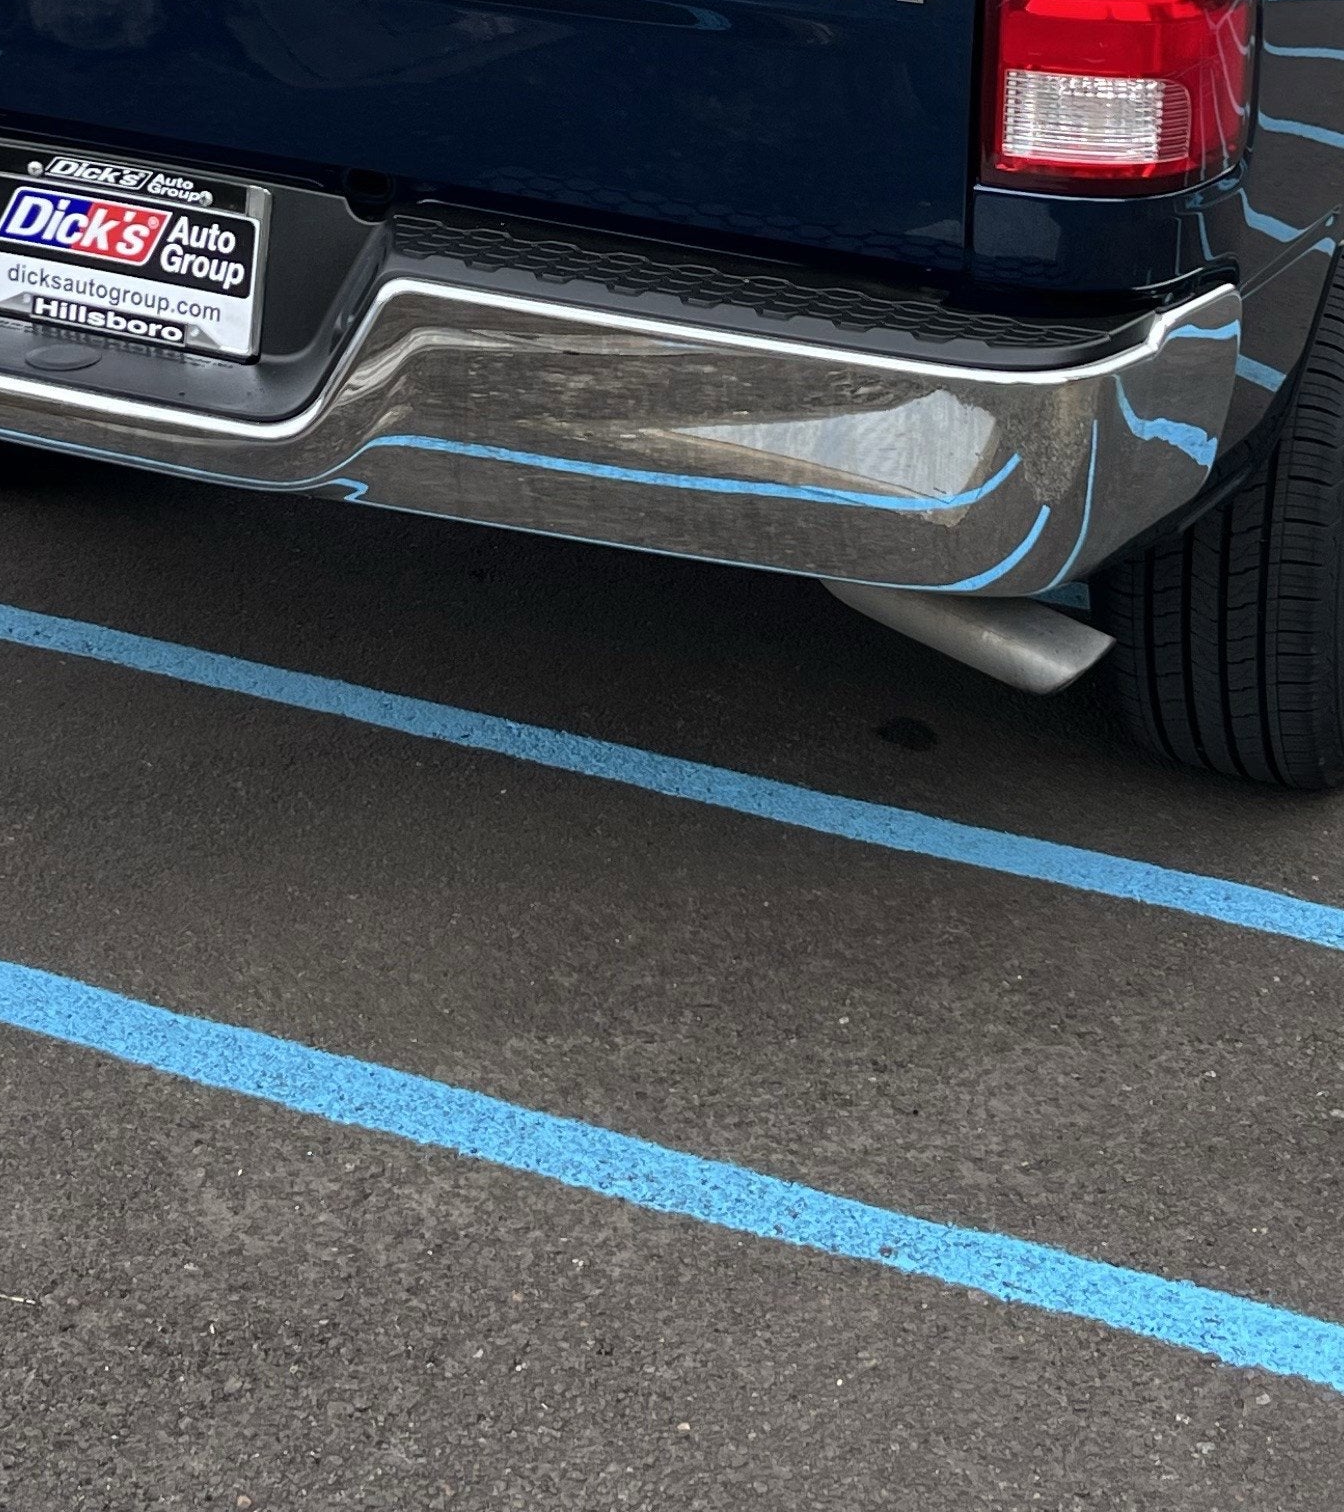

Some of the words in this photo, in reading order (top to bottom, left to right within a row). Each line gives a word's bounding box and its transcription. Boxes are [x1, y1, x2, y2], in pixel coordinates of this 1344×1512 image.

[50, 160, 141, 187] Dick's
[147, 183, 201, 202] Group
[153, 173, 194, 190] Auto
[5, 194, 150, 256] Dick's
[167, 216, 237, 254] Auto
[160, 244, 245, 289] Group
[7, 263, 222, 323] dicksautogroup.com
[33, 296, 184, 342] Hillsboro
